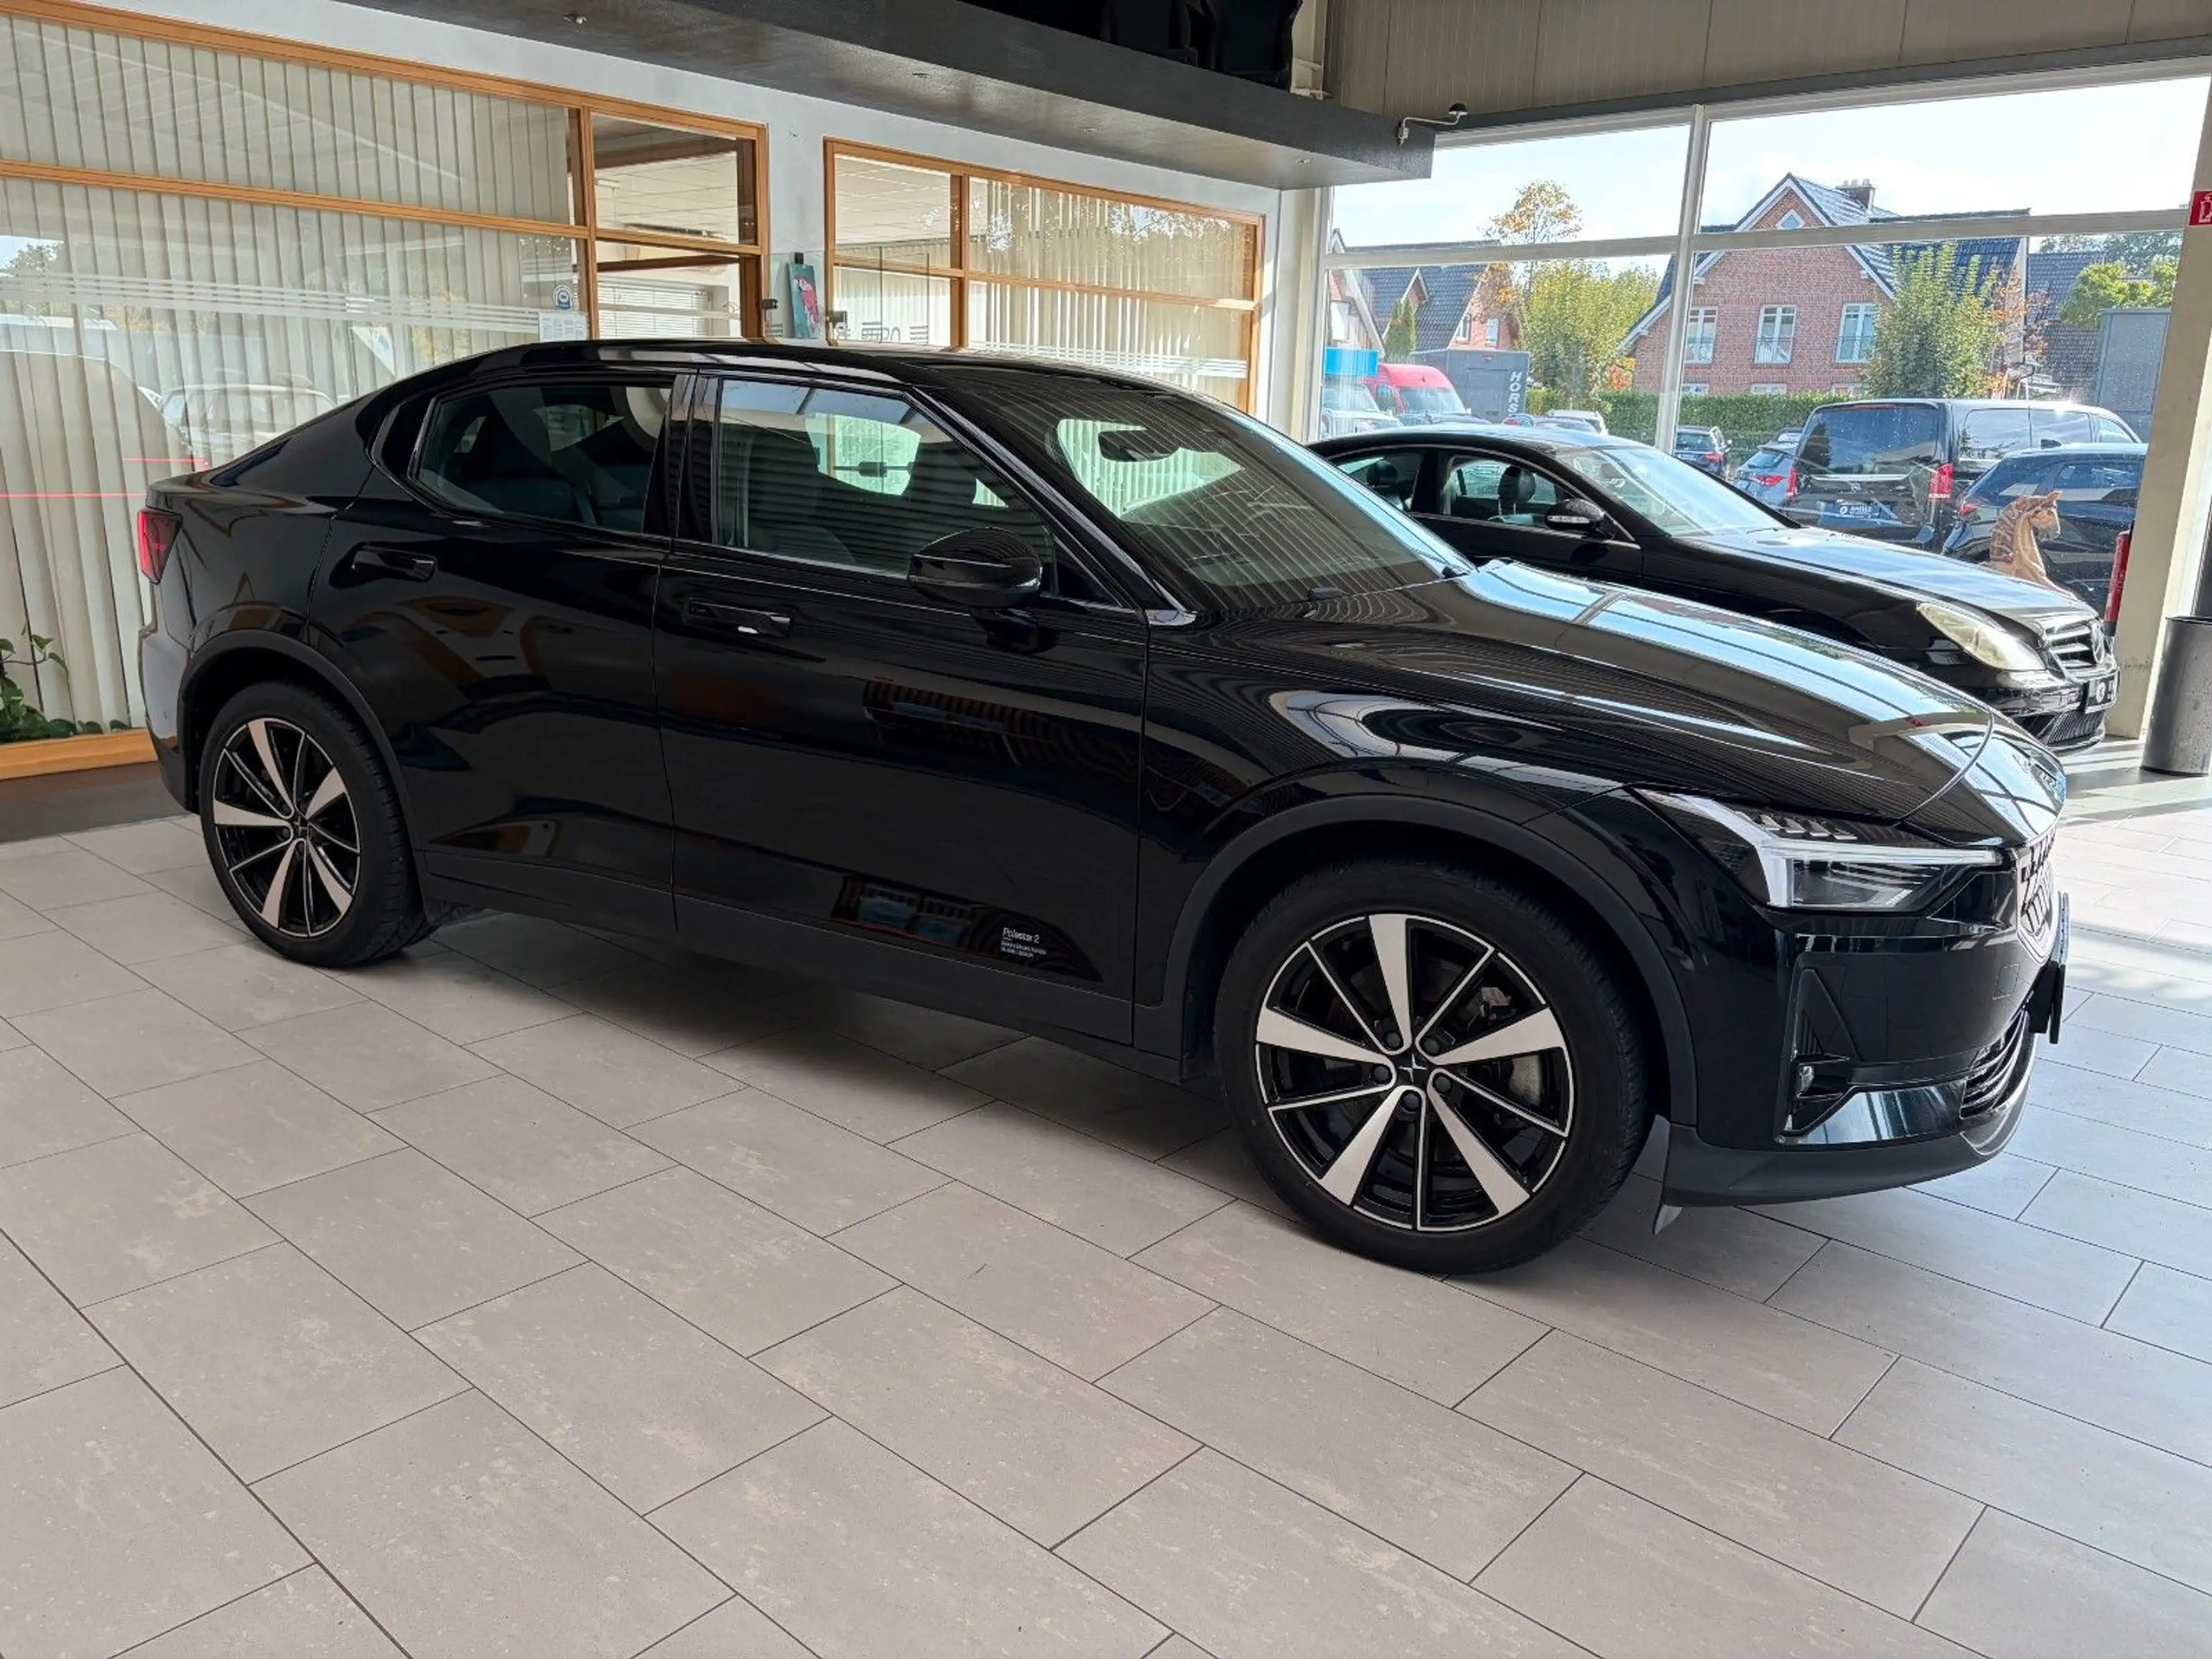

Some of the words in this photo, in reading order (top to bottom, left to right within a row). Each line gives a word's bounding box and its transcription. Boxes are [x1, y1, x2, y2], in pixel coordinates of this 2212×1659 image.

[1508, 372, 1523, 416] HORS
[1003, 927, 1033, 942] Polestar
[1034, 934, 1040, 944] 2
